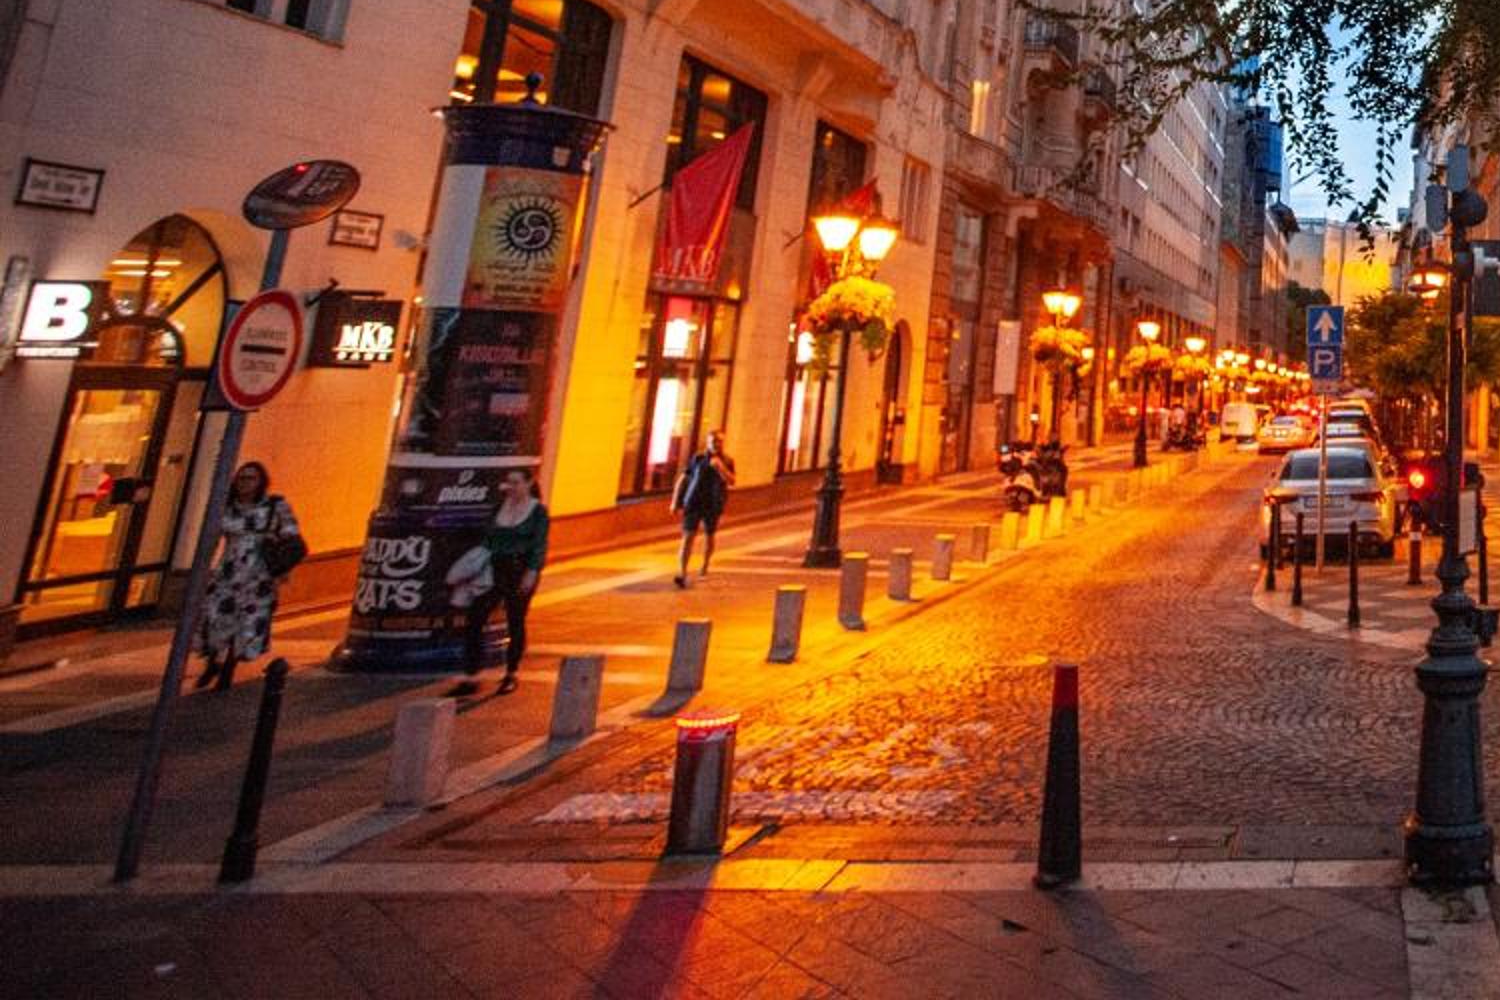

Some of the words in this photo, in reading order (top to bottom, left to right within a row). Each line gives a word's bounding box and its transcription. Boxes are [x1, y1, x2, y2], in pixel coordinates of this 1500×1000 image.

[20, 283, 93, 341] B
[337, 321, 394, 352] MKB
[1313, 349, 1335, 375] P
[364, 536, 432, 578] ADDY
